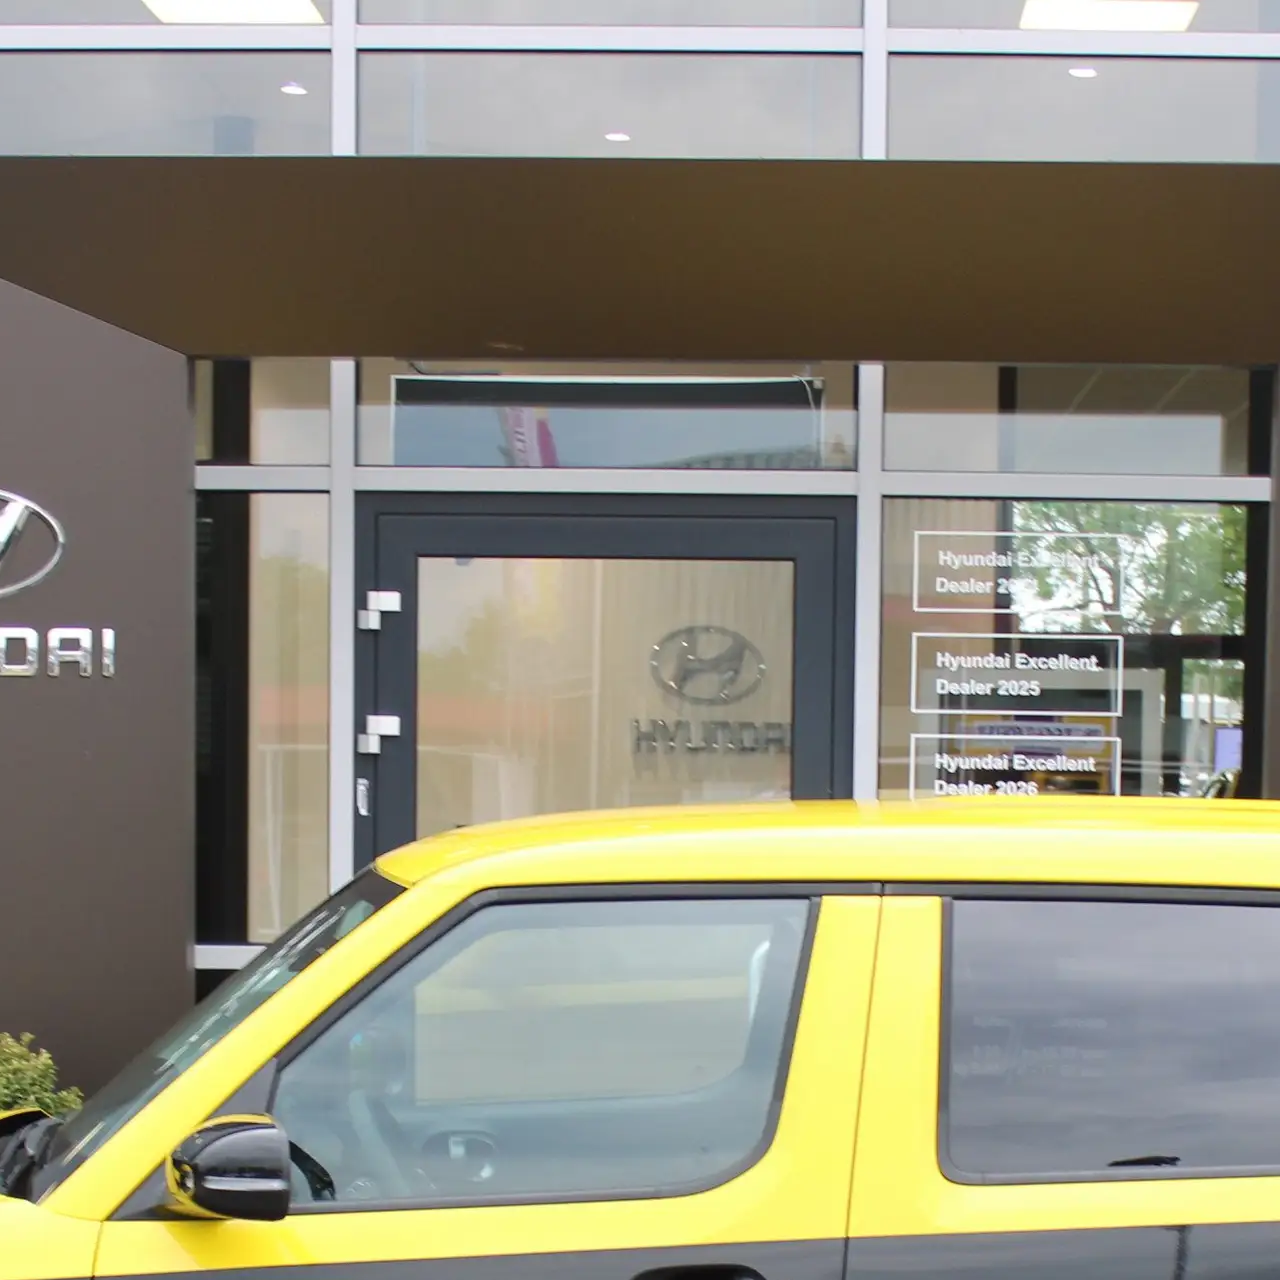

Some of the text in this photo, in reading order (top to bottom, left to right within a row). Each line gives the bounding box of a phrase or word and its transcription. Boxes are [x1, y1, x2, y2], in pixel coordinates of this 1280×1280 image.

[938, 550, 1012, 570] Hyundai
[935, 577, 994, 594] Dealer
[936, 652, 1011, 672] Hyundai
[936, 678, 1041, 697] Dealer 2025
[631, 719, 791, 754] HYUNDA
[935, 753, 1096, 773] Hyundai Excellent
[934, 780, 1039, 796] Dealer 2026
